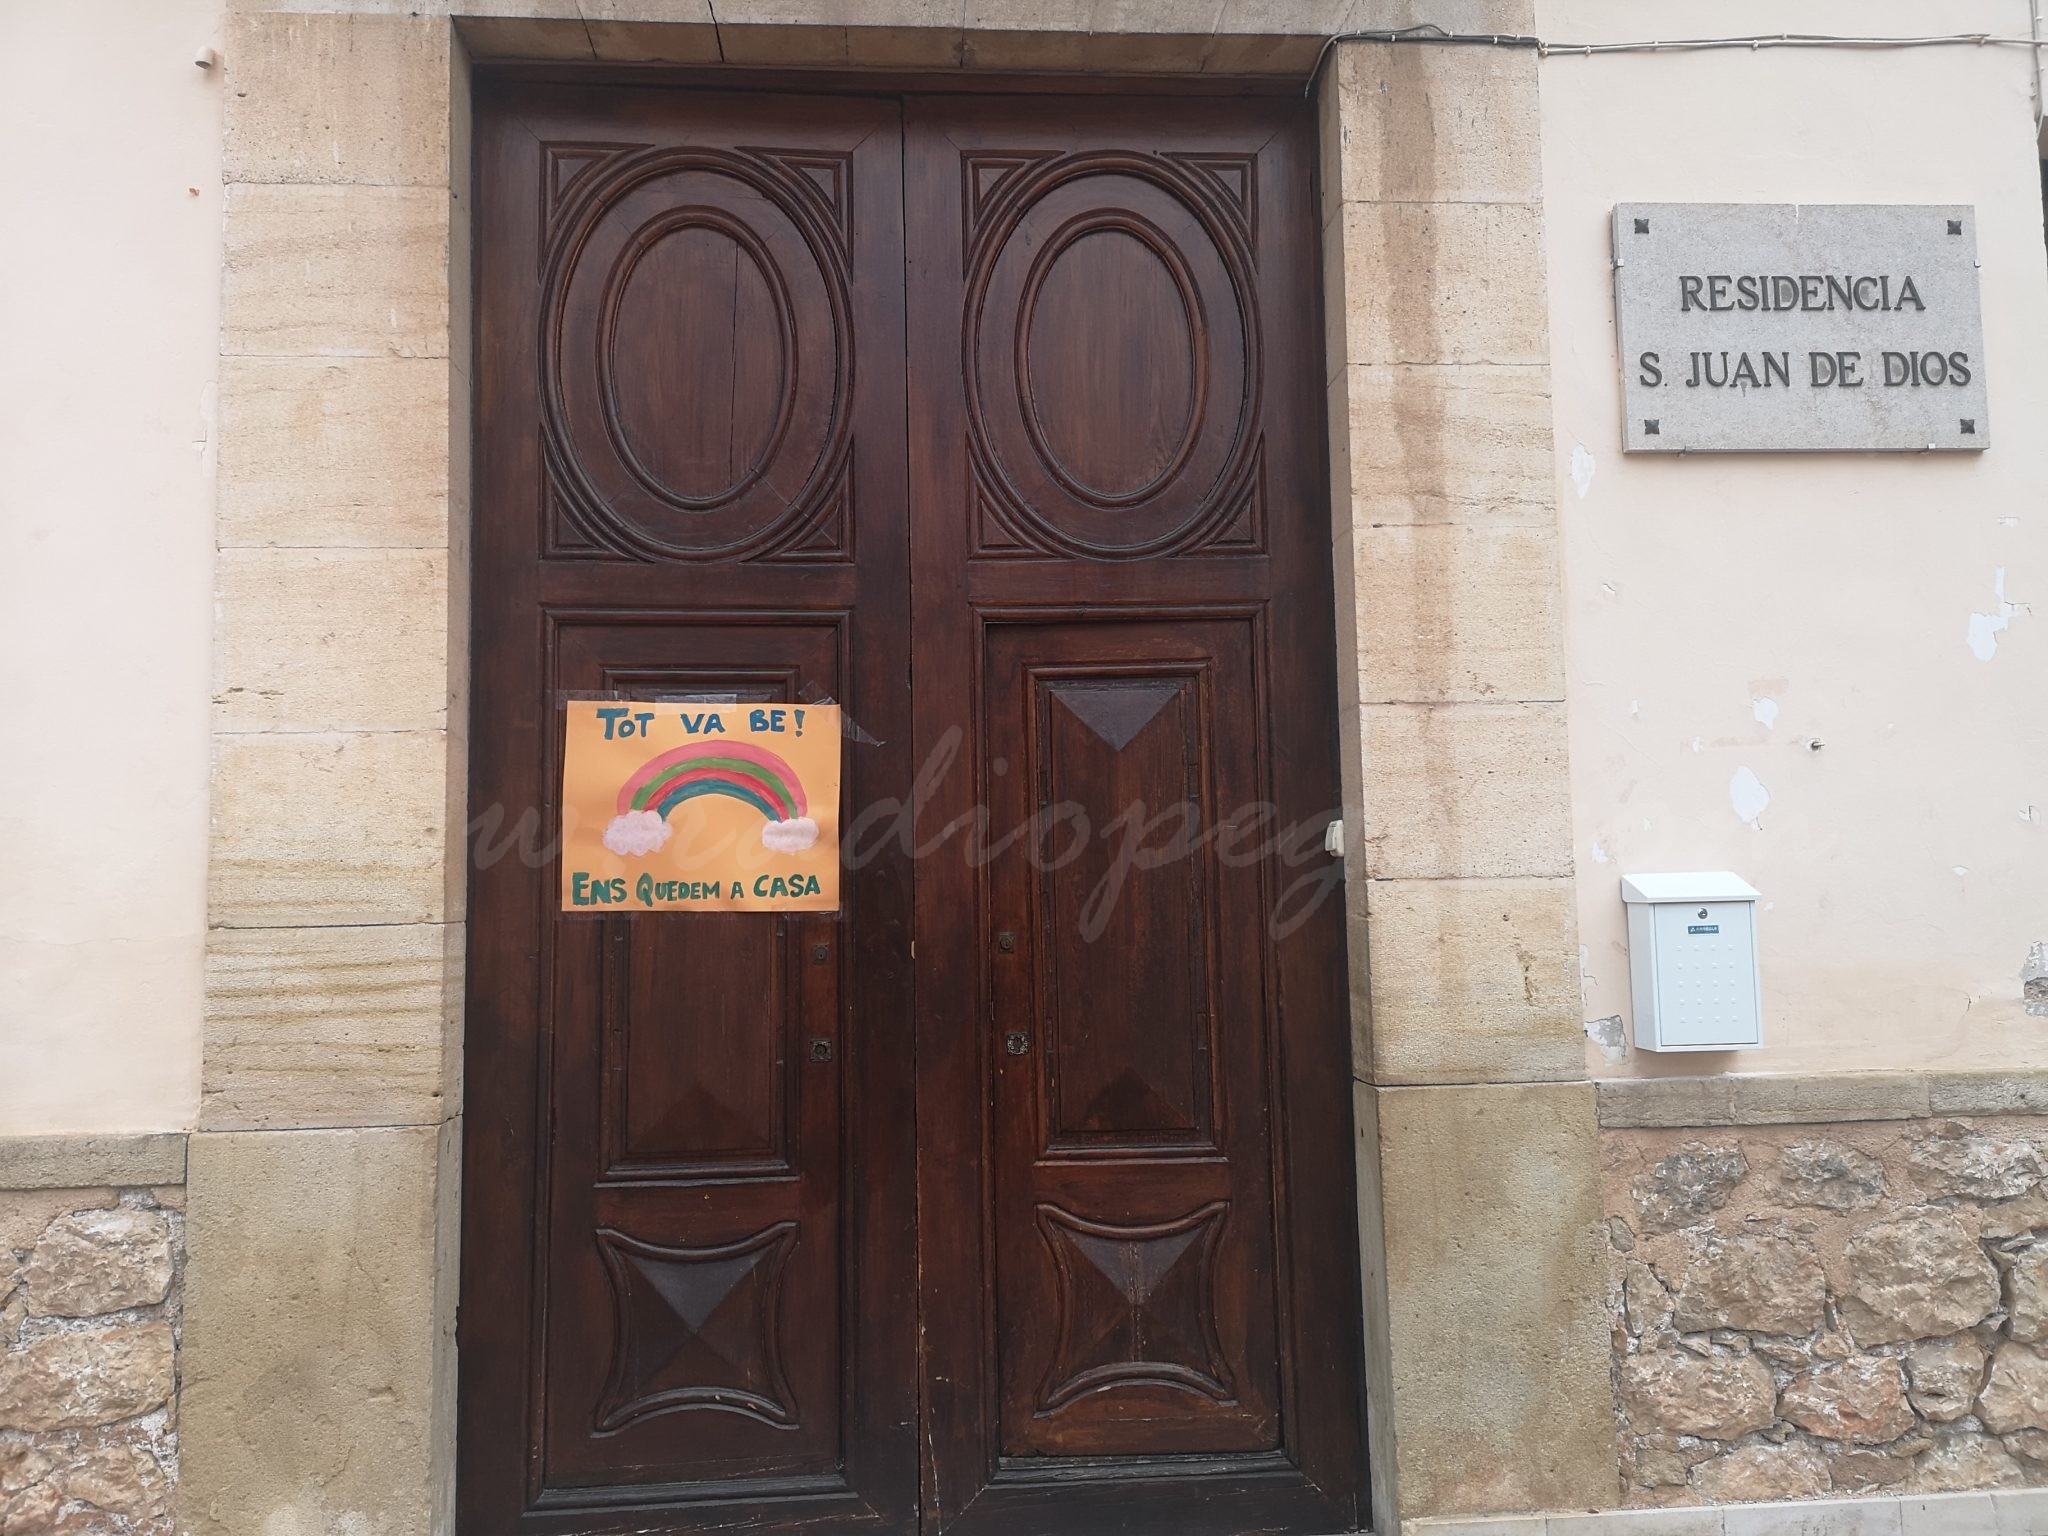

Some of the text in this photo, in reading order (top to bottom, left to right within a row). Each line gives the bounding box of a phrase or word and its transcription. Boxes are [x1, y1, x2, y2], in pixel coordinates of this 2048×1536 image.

[1679, 275, 1926, 312] RESIDENCIA
[1639, 351, 1972, 388] S. JUAN DE DIOS
[596, 707, 655, 740] TOT
[680, 712, 726, 735] VA
[572, 872, 821, 907] ENS QUEDEM A CASA
